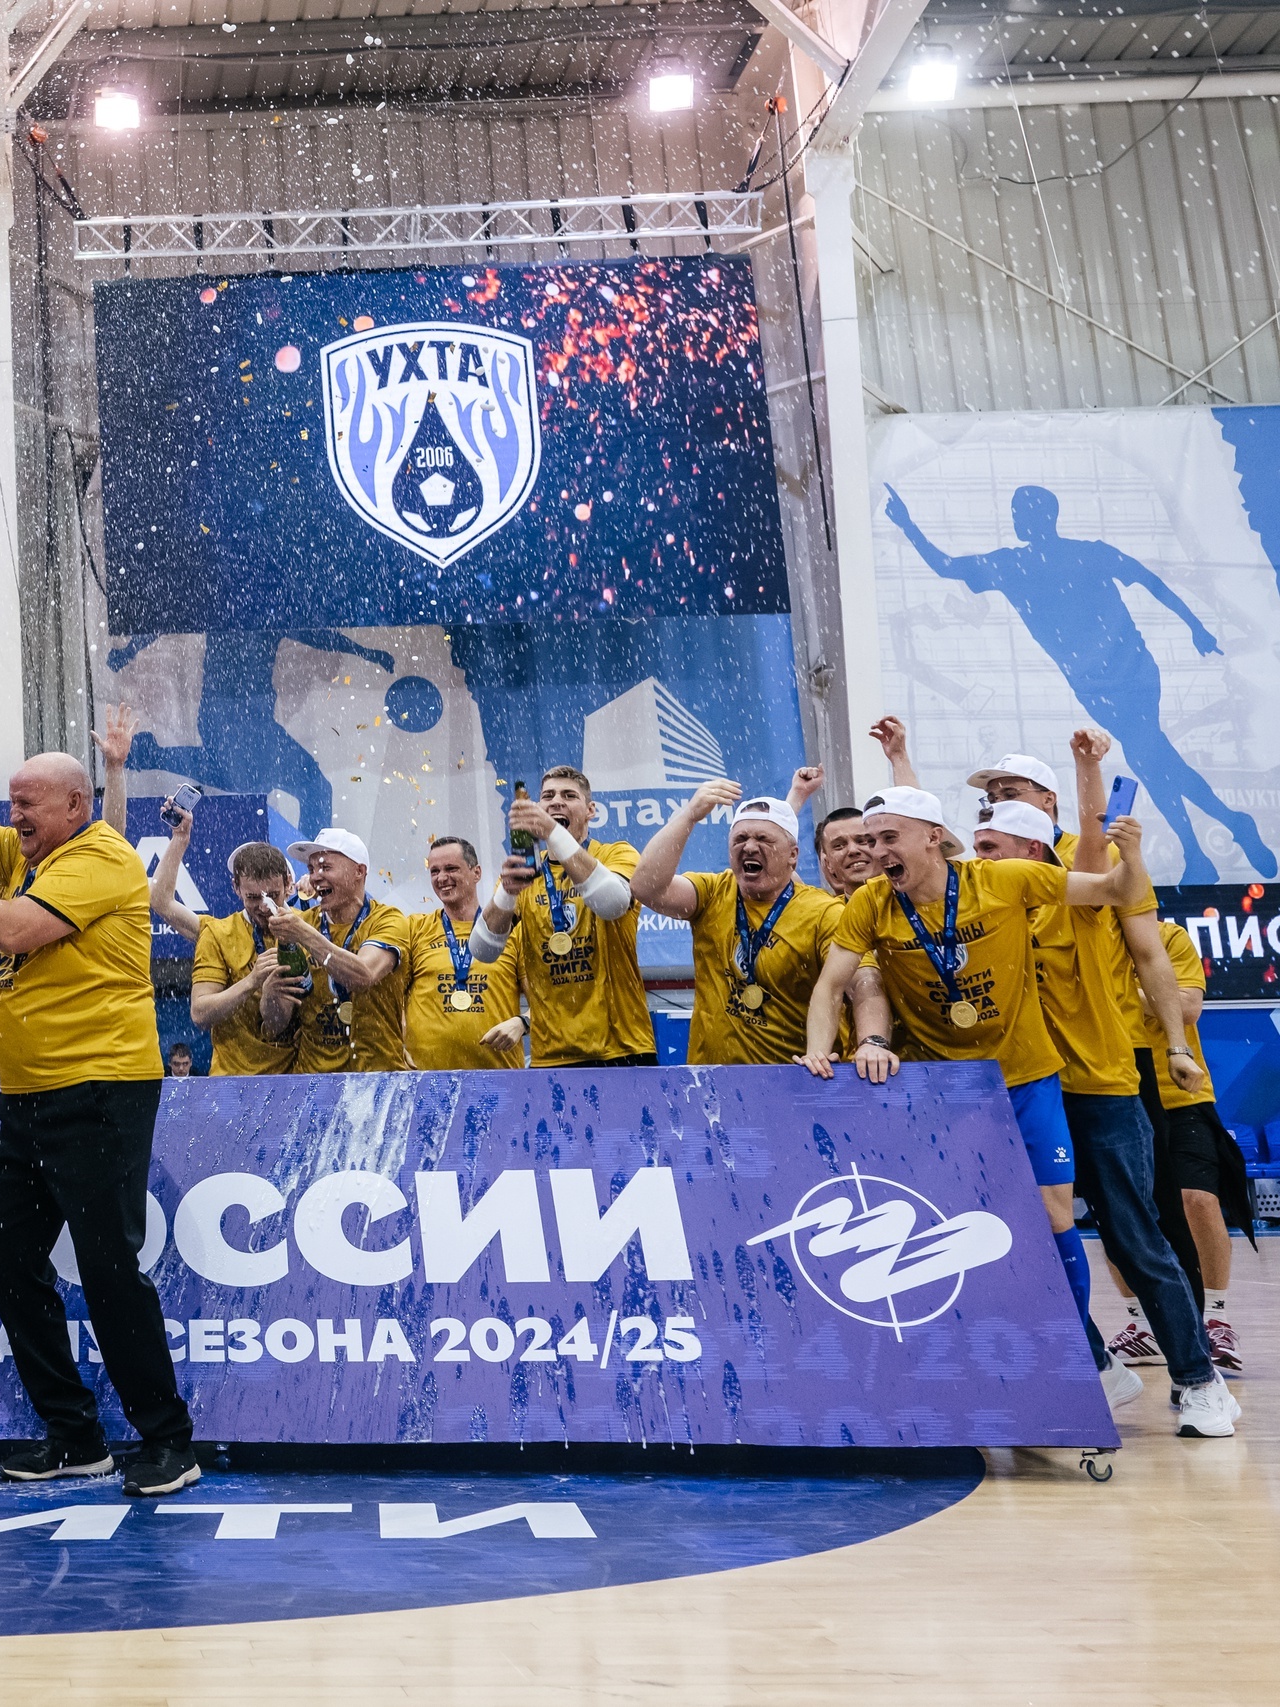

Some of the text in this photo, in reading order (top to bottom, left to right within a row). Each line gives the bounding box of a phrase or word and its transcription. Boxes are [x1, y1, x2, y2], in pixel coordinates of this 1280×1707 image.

[365, 340, 490, 391] УХТА
[416, 446, 454, 468] 2006
[432, 1309, 702, 1369] 2024/25
